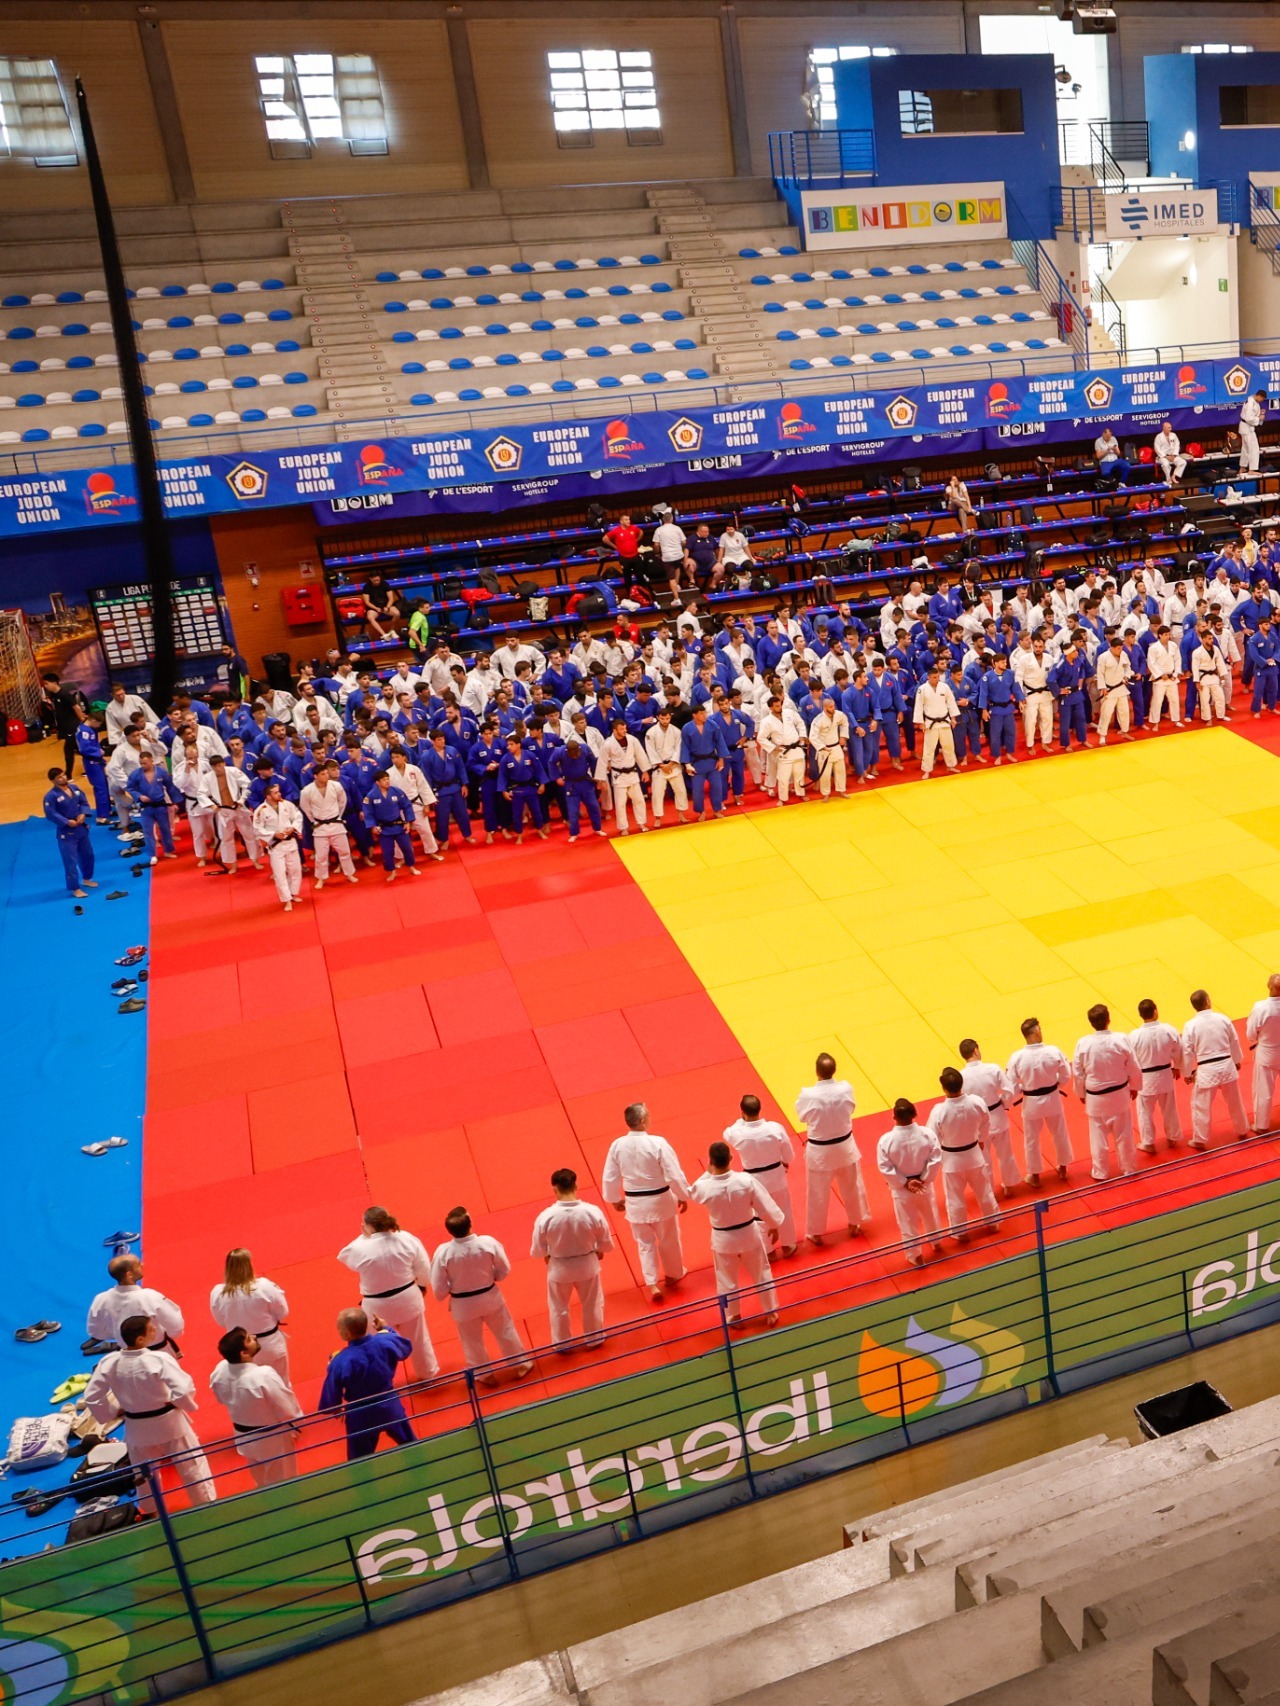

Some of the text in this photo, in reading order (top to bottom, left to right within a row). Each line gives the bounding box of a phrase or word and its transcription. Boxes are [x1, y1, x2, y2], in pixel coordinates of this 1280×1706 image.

[809, 198, 1001, 232] BENIDORM
[1153, 203, 1205, 221] IMED
[1154, 218, 1205, 228] HOSPITALES
[1121, 371, 1166, 384] EUROPEAN
[1028, 379, 1075, 393] EUROPEAN
[1133, 382, 1156, 394] JUDO
[927, 387, 975, 402] EUROPEAN
[1041, 391, 1063, 403] JUDO
[1131, 393, 1159, 405] UNION
[824, 397, 875, 412] EUROPEAN
[940, 400, 964, 413] JUDO
[989, 402, 1021, 414] ESPAÑA
[1039, 401, 1067, 414] UNION
[712, 408, 766, 424] EUROPEAN
[838, 409, 863, 423] JUDO
[937, 412, 968, 425] UNION
[1084, 413, 1123, 424] DE L'ESPORT
[1131, 411, 1170, 421] SERVIGROUP
[533, 426, 590, 443] EUROPEAN
[728, 421, 754, 435] JUDO
[783, 422, 816, 435] ESPAÑA
[836, 422, 867, 436] UNION
[998, 421, 1046, 438] DORM
[411, 438, 472, 456] EUROPEAN
[550, 440, 577, 454] JUDO
[609, 440, 645, 454] ESPAÑA
[725, 433, 759, 448] UNION
[841, 441, 885, 452] SERVIGROUP
[786, 444, 830, 456] DE L'ESPORT
[851, 449, 875, 457] HOTELES
[278, 451, 342, 469] EUROPEAN
[429, 452, 459, 467] JUDO
[547, 452, 583, 467] UNION
[688, 454, 742, 471] DORM
[298, 466, 329, 480] JUDO
[364, 467, 404, 481] ESPAÑA
[427, 464, 465, 480] UNION
[0, 479, 67, 498] EUROPEAN
[164, 480, 198, 494] JUDO
[296, 478, 336, 494] UNION
[442, 485, 494, 495] DE L'ESPORT
[511, 479, 559, 492] SERVIGROUP
[523, 487, 548, 496] HOTELES
[18, 495, 53, 510] JUDO
[93, 495, 137, 510] ESPAÑA
[164, 492, 205, 508] UNION
[331, 493, 394, 512] DORM
[16, 508, 61, 524] UNION
[123, 585, 141, 596] LIGA
[31, 1418, 42, 1441] ORTH
[41, 1425, 50, 1440] THE
